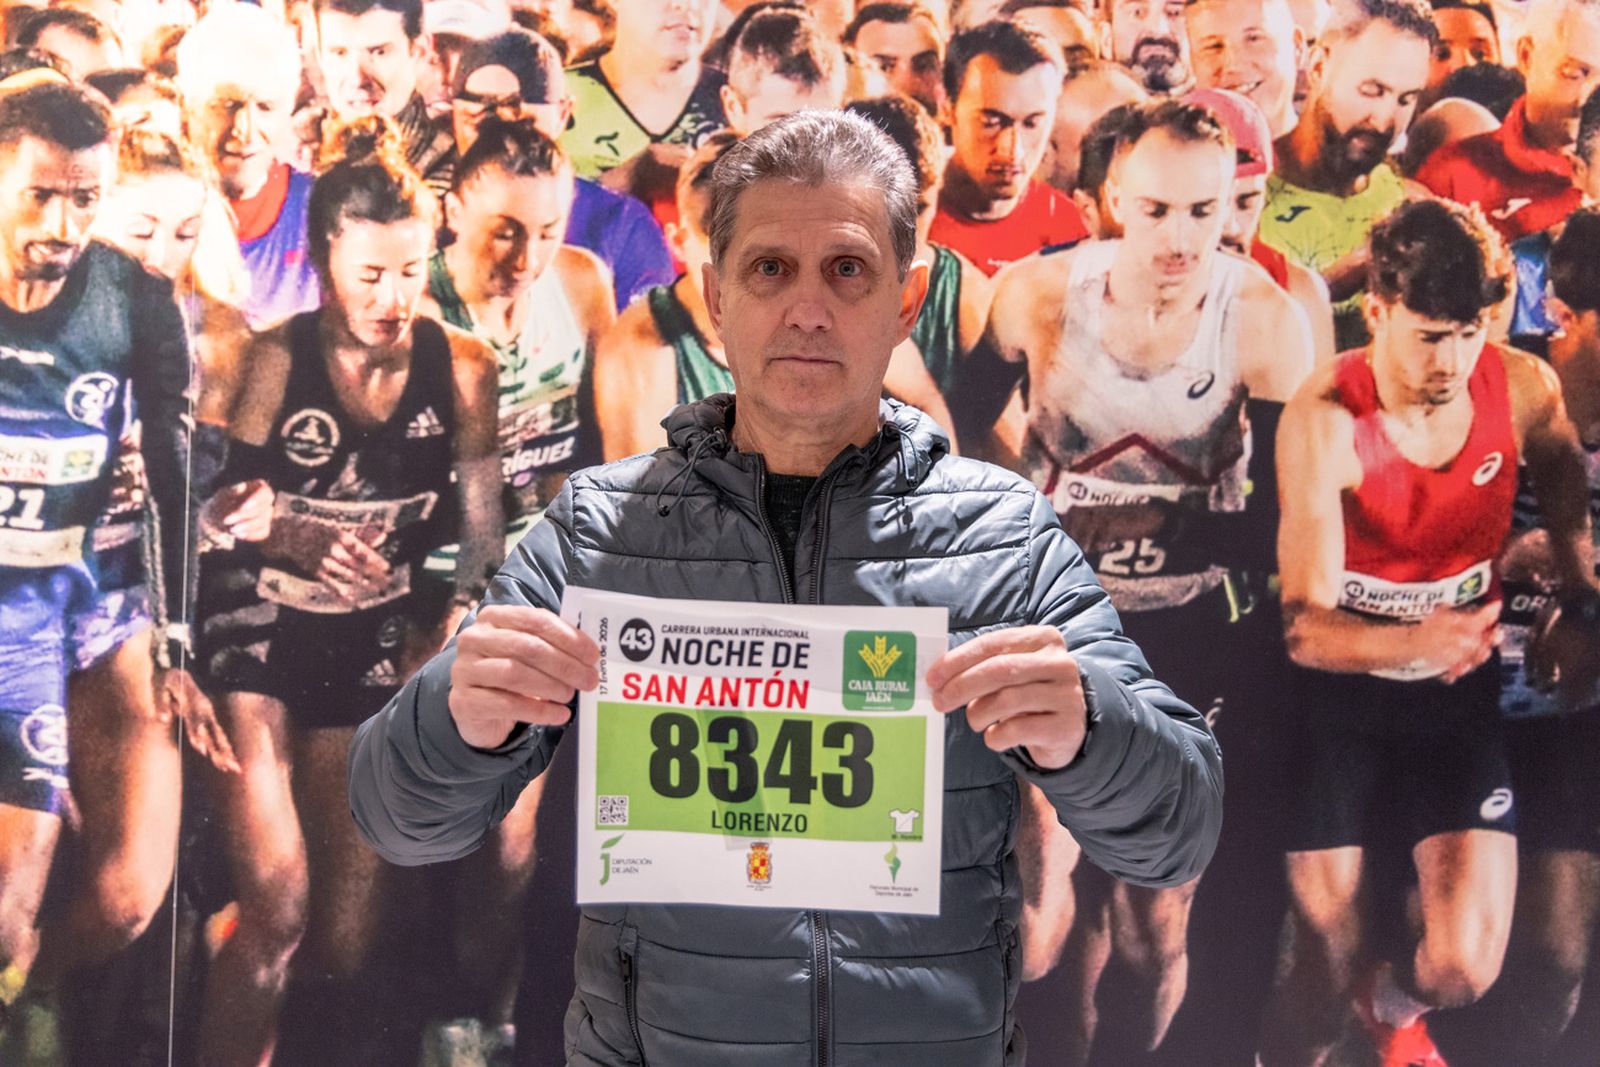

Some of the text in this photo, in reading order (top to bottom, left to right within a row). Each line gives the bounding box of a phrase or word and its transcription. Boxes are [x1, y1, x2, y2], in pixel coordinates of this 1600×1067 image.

[1098, 538, 1166, 575] 25
[620, 627, 653, 652] 43
[661, 624, 809, 640] CARRERA URBANA INTERNACIONAL
[599, 617, 608, 695] 17 Enero de 2026
[660, 637, 811, 669] NOCHE DE
[621, 669, 810, 709] SAN ANTÓN
[649, 712, 874, 809] 8343
[711, 810, 808, 833] LORENZO
